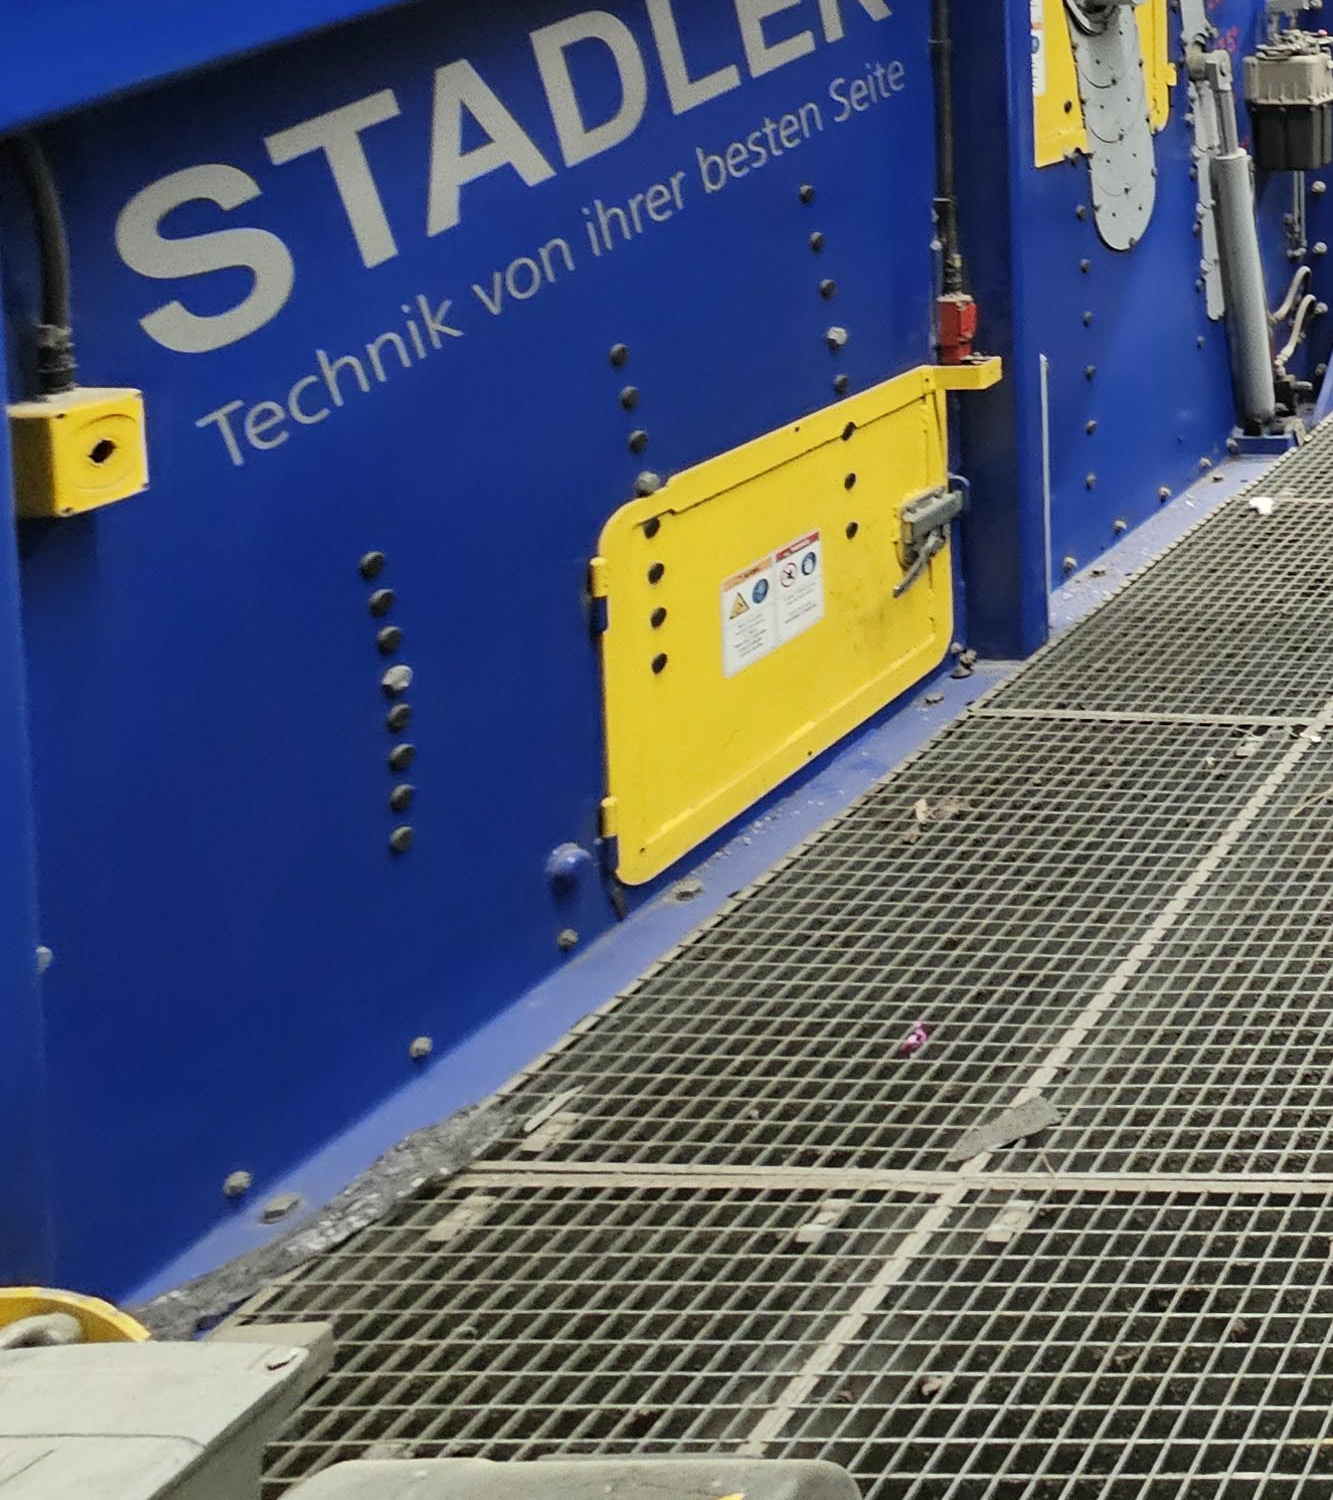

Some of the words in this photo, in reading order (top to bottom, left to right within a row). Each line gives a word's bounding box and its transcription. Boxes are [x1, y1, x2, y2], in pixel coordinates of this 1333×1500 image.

[194, 294, 464, 468] Technik
[471, 236, 576, 317] von
[581, 170, 685, 258] ihrer
[695, 101, 822, 195] besten
[829, 60, 906, 123] Seite
